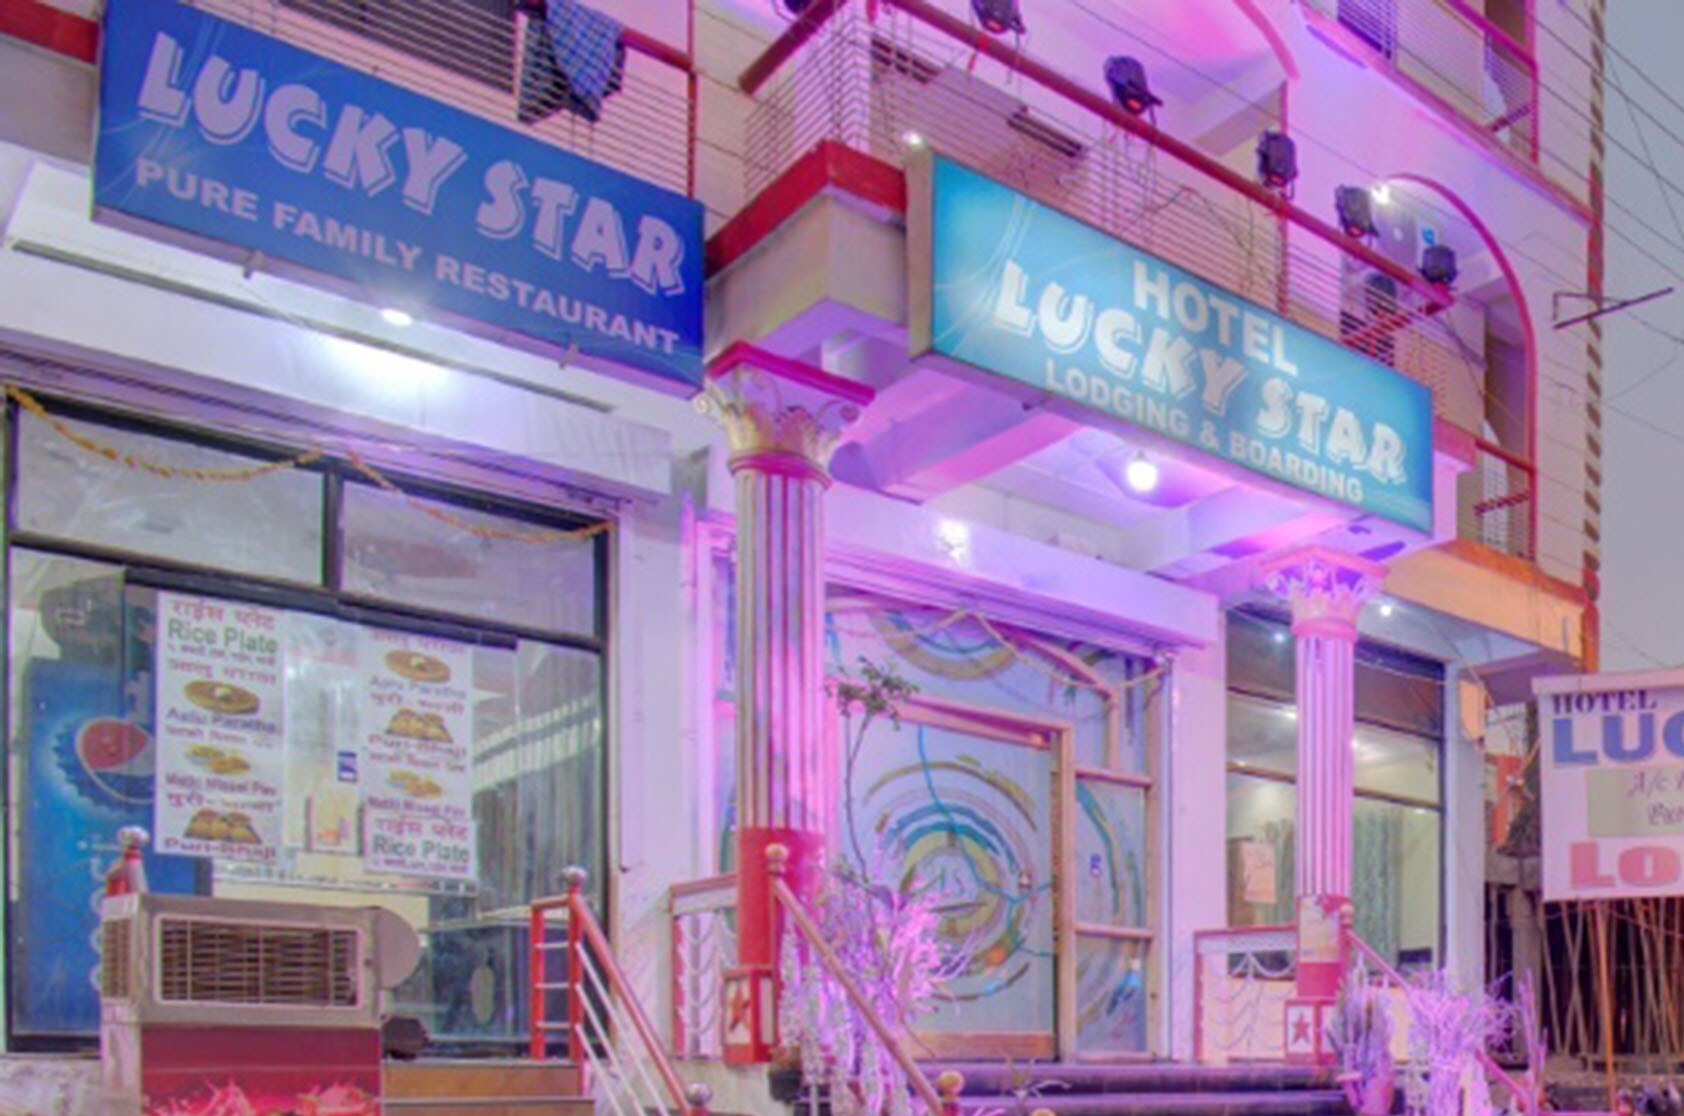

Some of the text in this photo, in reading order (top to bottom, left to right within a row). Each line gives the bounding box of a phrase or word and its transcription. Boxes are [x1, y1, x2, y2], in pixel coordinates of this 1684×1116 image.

[136, 31, 686, 296] LUCKY STAR
[136, 157, 679, 356] PURE FAMILY RESTAURANT
[1134, 260, 1297, 375] HOTEL
[994, 259, 1408, 484] LUCKY STAR
[1044, 358, 1363, 502] LODGING & BOARDING
[168, 618, 217, 645] Rice
[224, 627, 278, 654] Plate
[1551, 689, 1657, 714] HOTEL
[373, 833, 470, 862] Rice Plate
